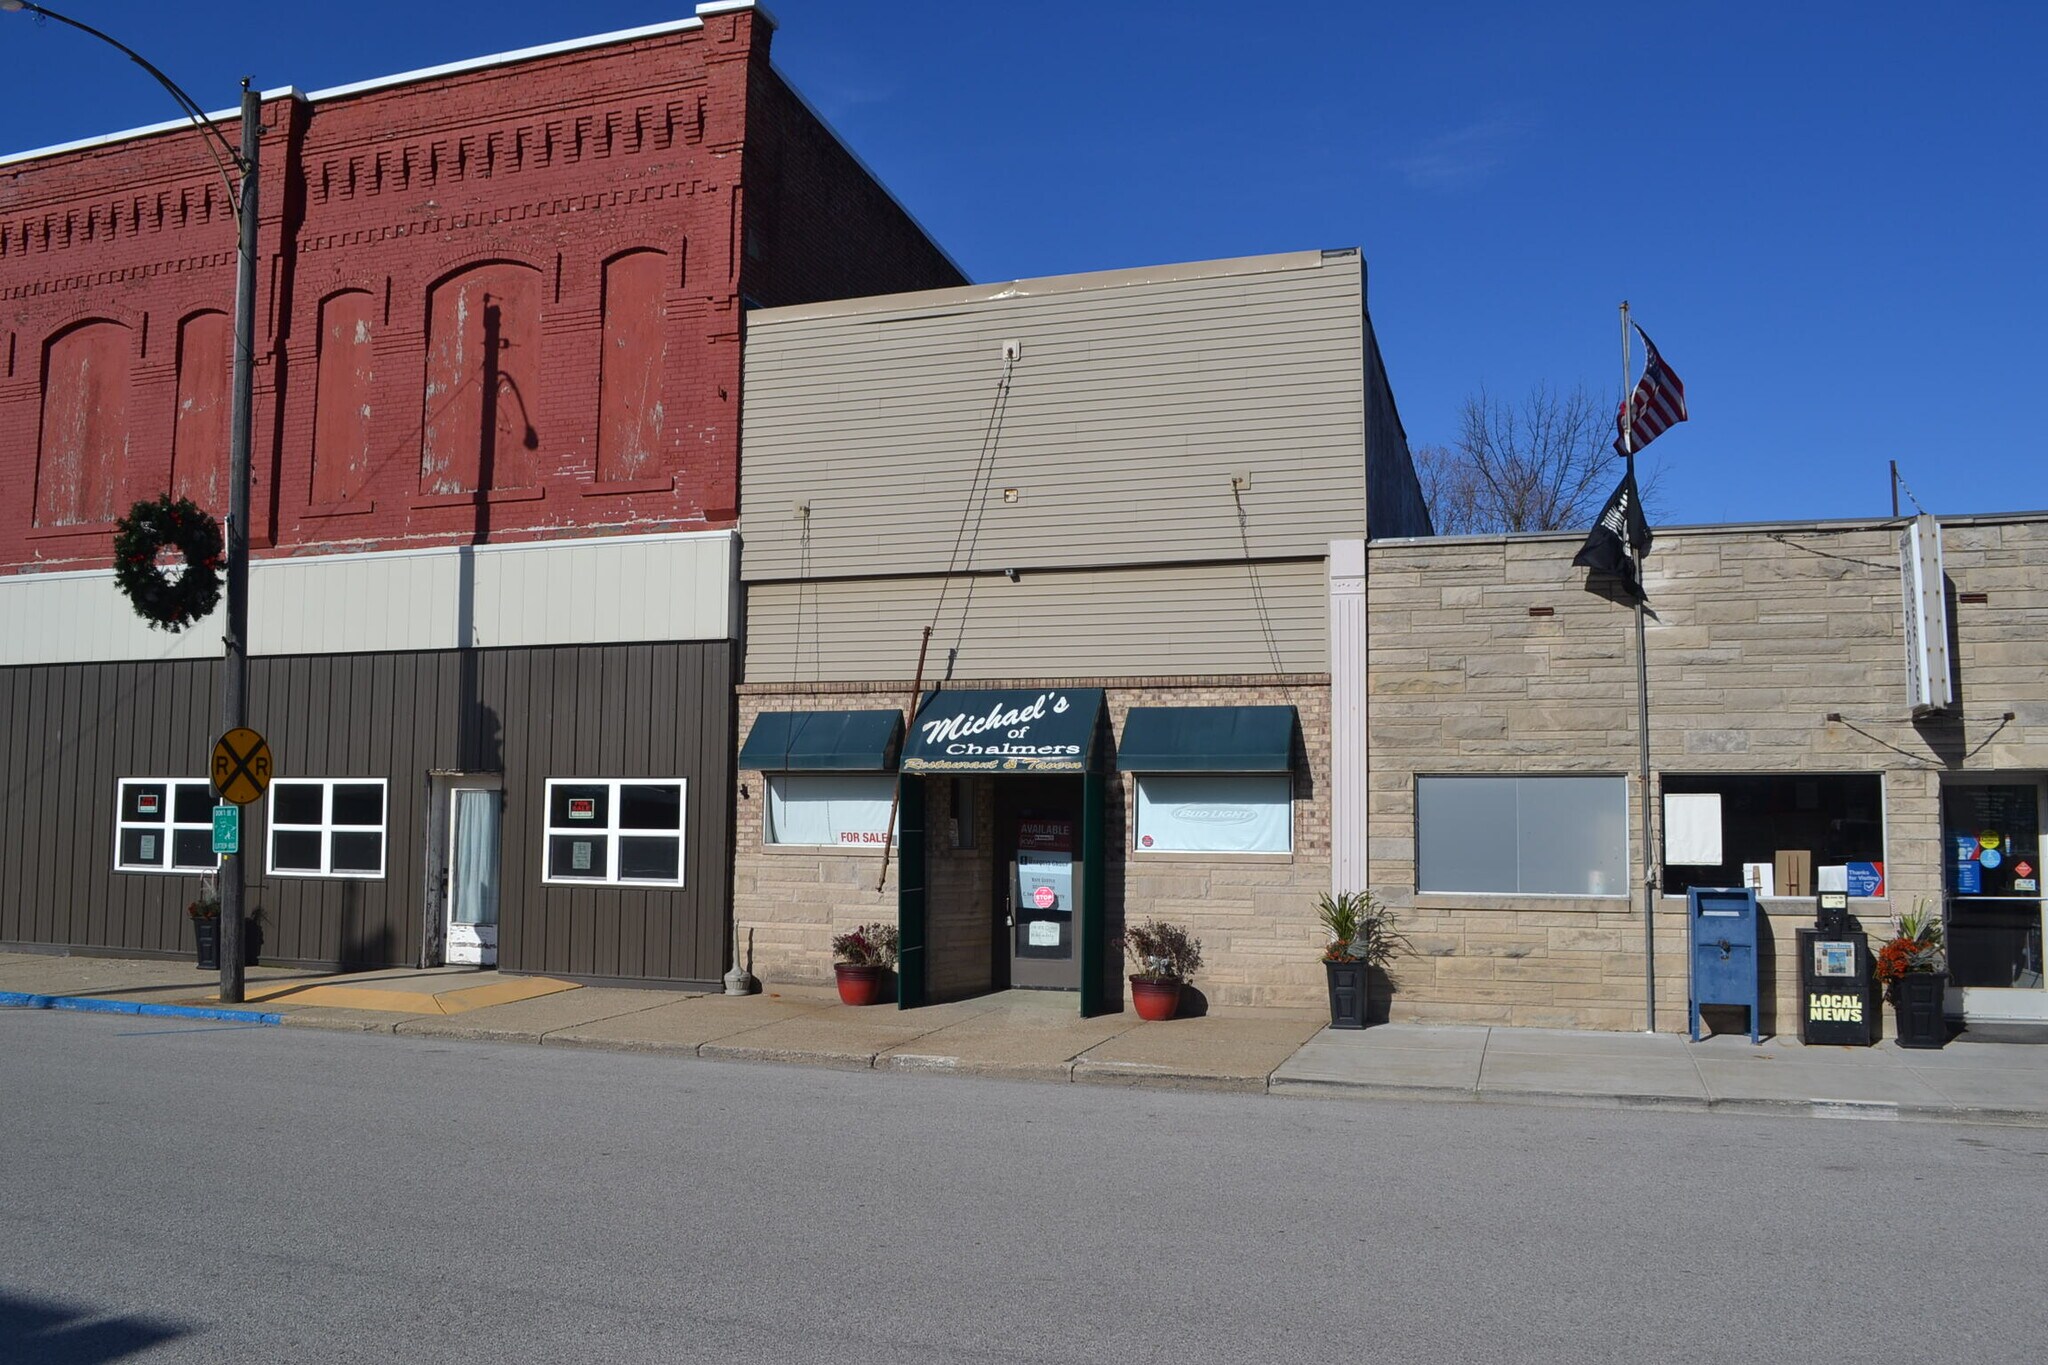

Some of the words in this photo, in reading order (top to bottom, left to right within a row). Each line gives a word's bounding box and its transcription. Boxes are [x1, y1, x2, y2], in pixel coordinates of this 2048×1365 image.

[922, 692, 1069, 744] Michael's
[1007, 726, 1030, 739] of
[946, 743, 1080, 755] Chalmers
[216, 756, 229, 775] R
[255, 757, 268, 776] R
[904, 758, 999, 770] Restaurant
[1003, 760, 1018, 770] &
[1022, 759, 1083, 770] Tavern
[1180, 808, 1208, 818] BUD
[1212, 809, 1251, 819] LIGHT
[1021, 824, 1070, 835] AVAILABLE
[841, 832, 859, 842] FOR
[863, 832, 888, 843] SALE
[1810, 994, 1862, 1008] LOCAL
[1810, 1008, 1862, 1022] NEWS
